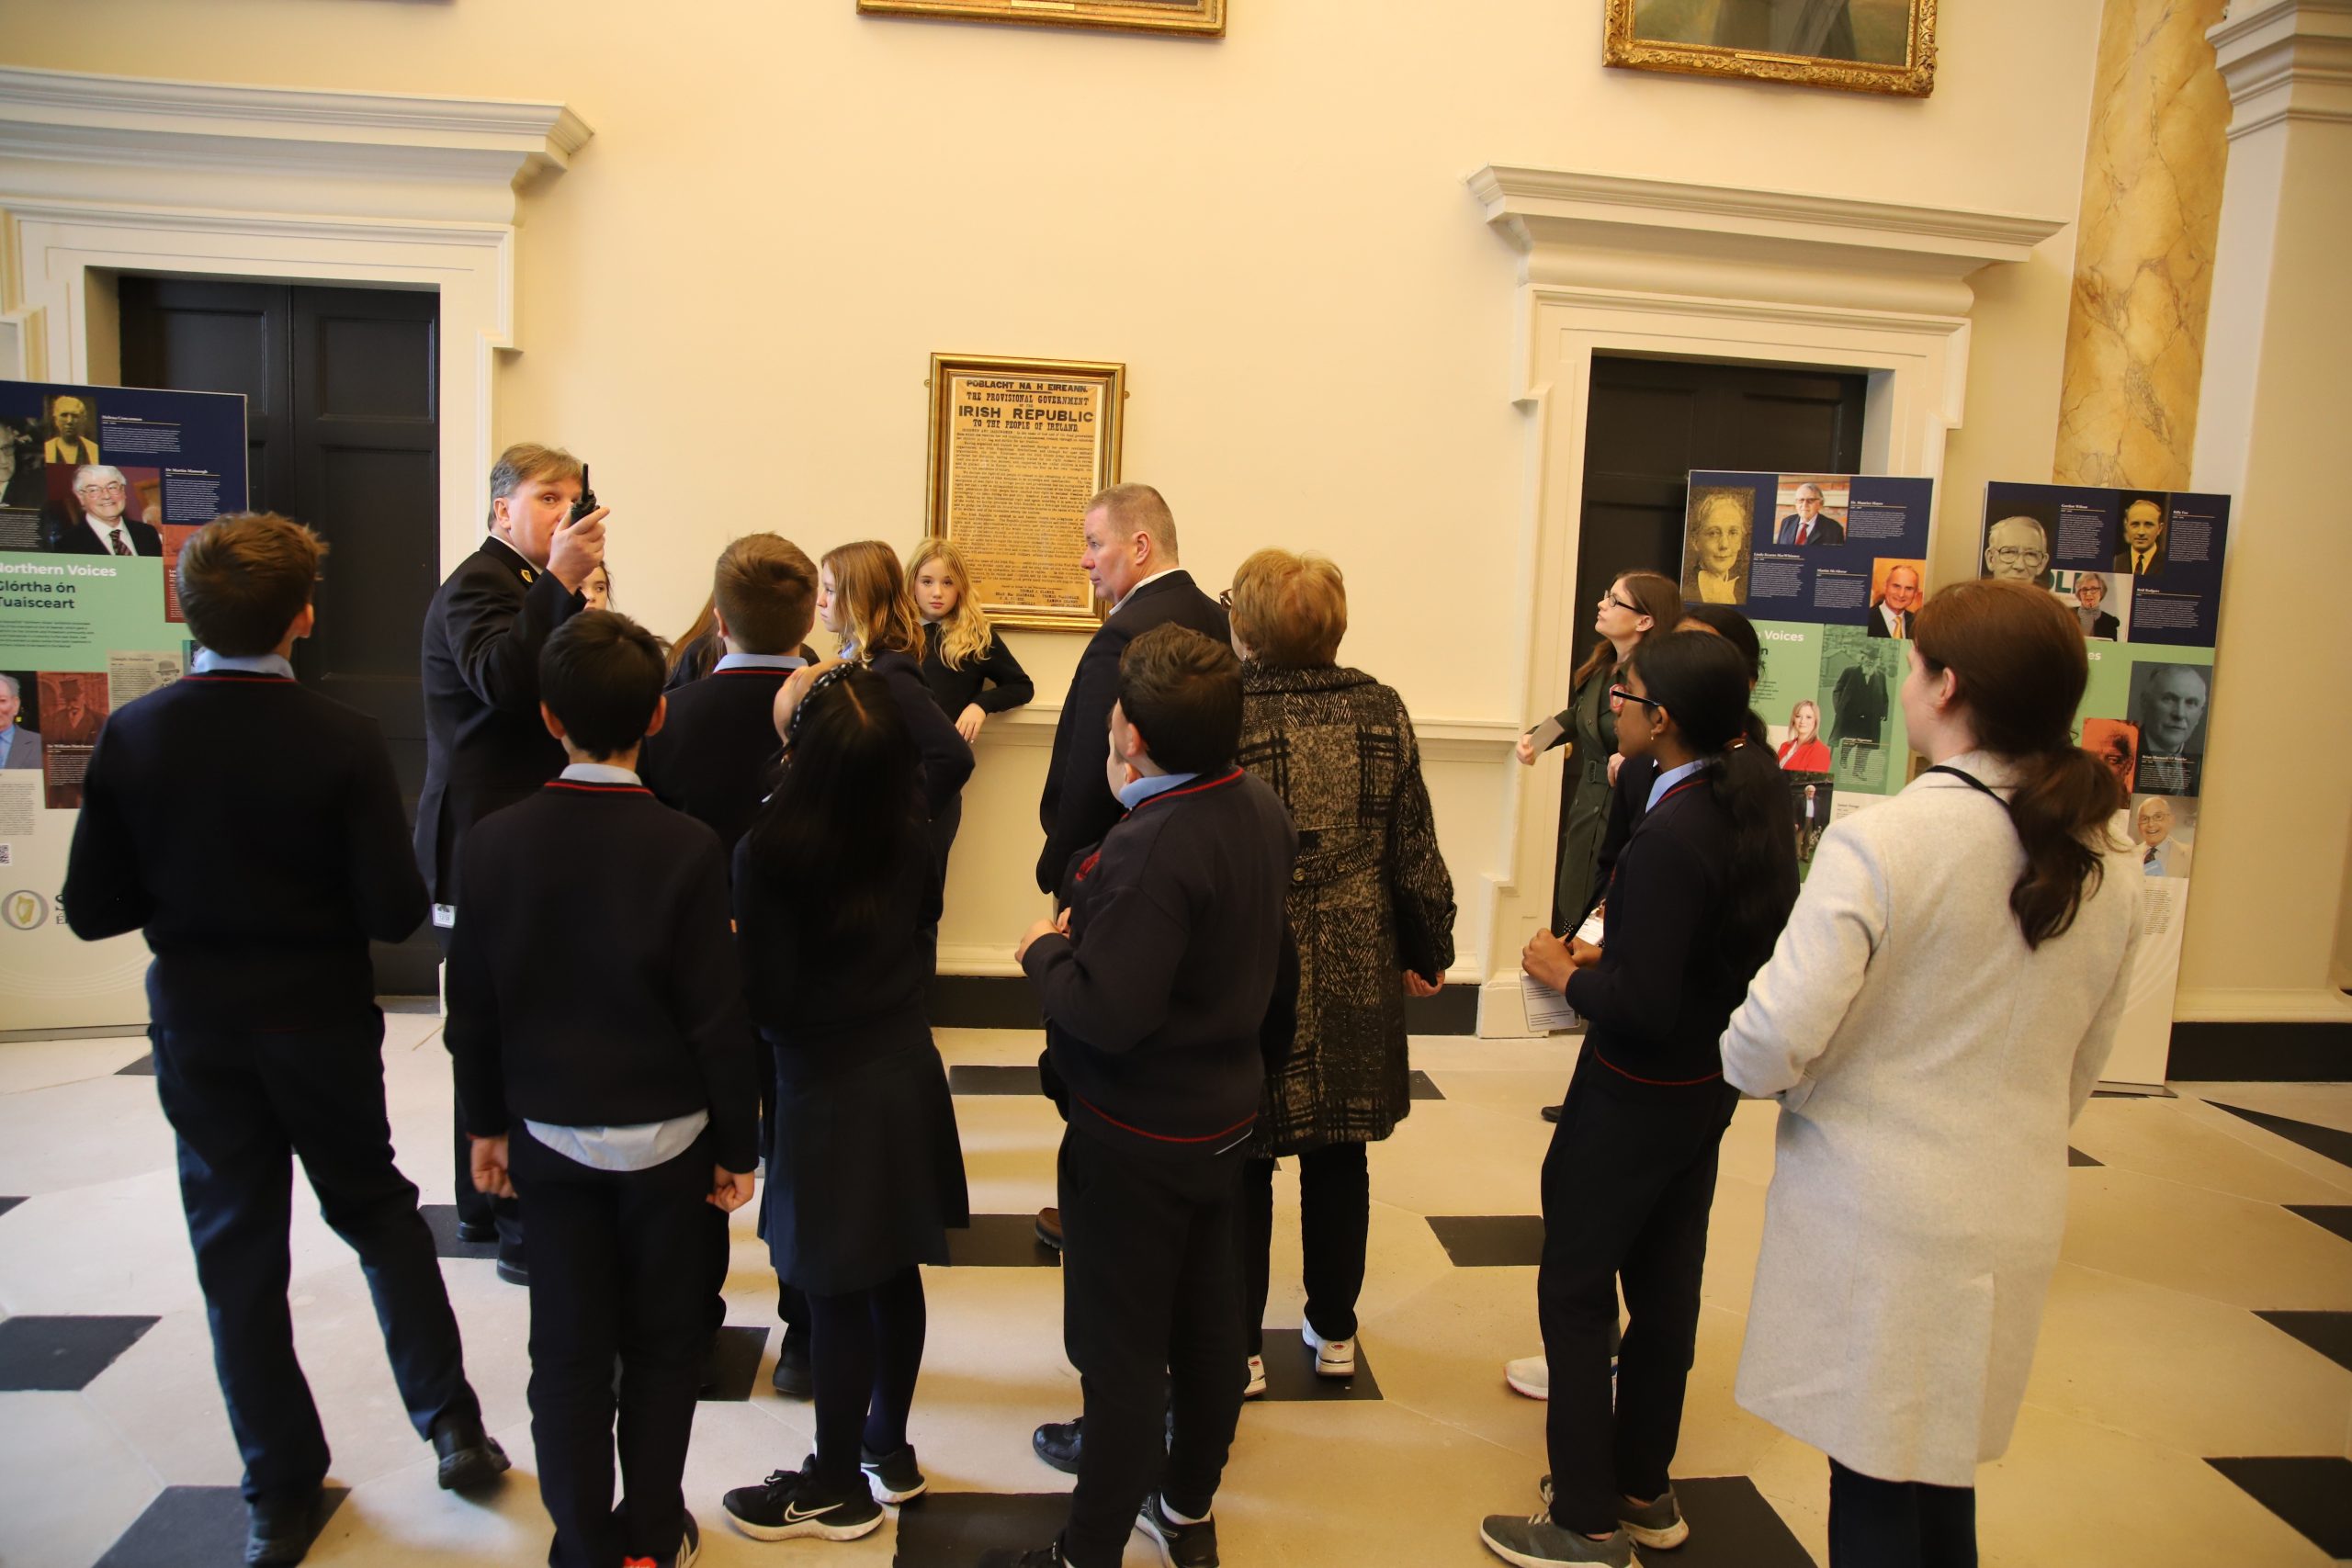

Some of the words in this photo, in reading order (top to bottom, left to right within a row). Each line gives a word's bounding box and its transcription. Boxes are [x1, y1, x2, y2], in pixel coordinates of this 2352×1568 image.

[967, 379, 1014, 389] POBLACHT
[1019, 382, 1032, 390] NA
[1036, 382, 1044, 390] H
[967, 391, 981, 400] THE
[986, 392, 1034, 403] PROVISIONAL
[1037, 395, 1090, 406] GOVERNMENT
[958, 405, 1001, 418] IRISH
[1012, 408, 1094, 423] REPUBLIC
[973, 419, 982, 427] TO
[987, 420, 1001, 429] THE
[1005, 420, 1030, 430] PEOPLE
[1035, 422, 1043, 430] OF
[66, 564, 118, 577] Voices
[56, 581, 76, 593] ón
[1764, 630, 1805, 642] Voices
